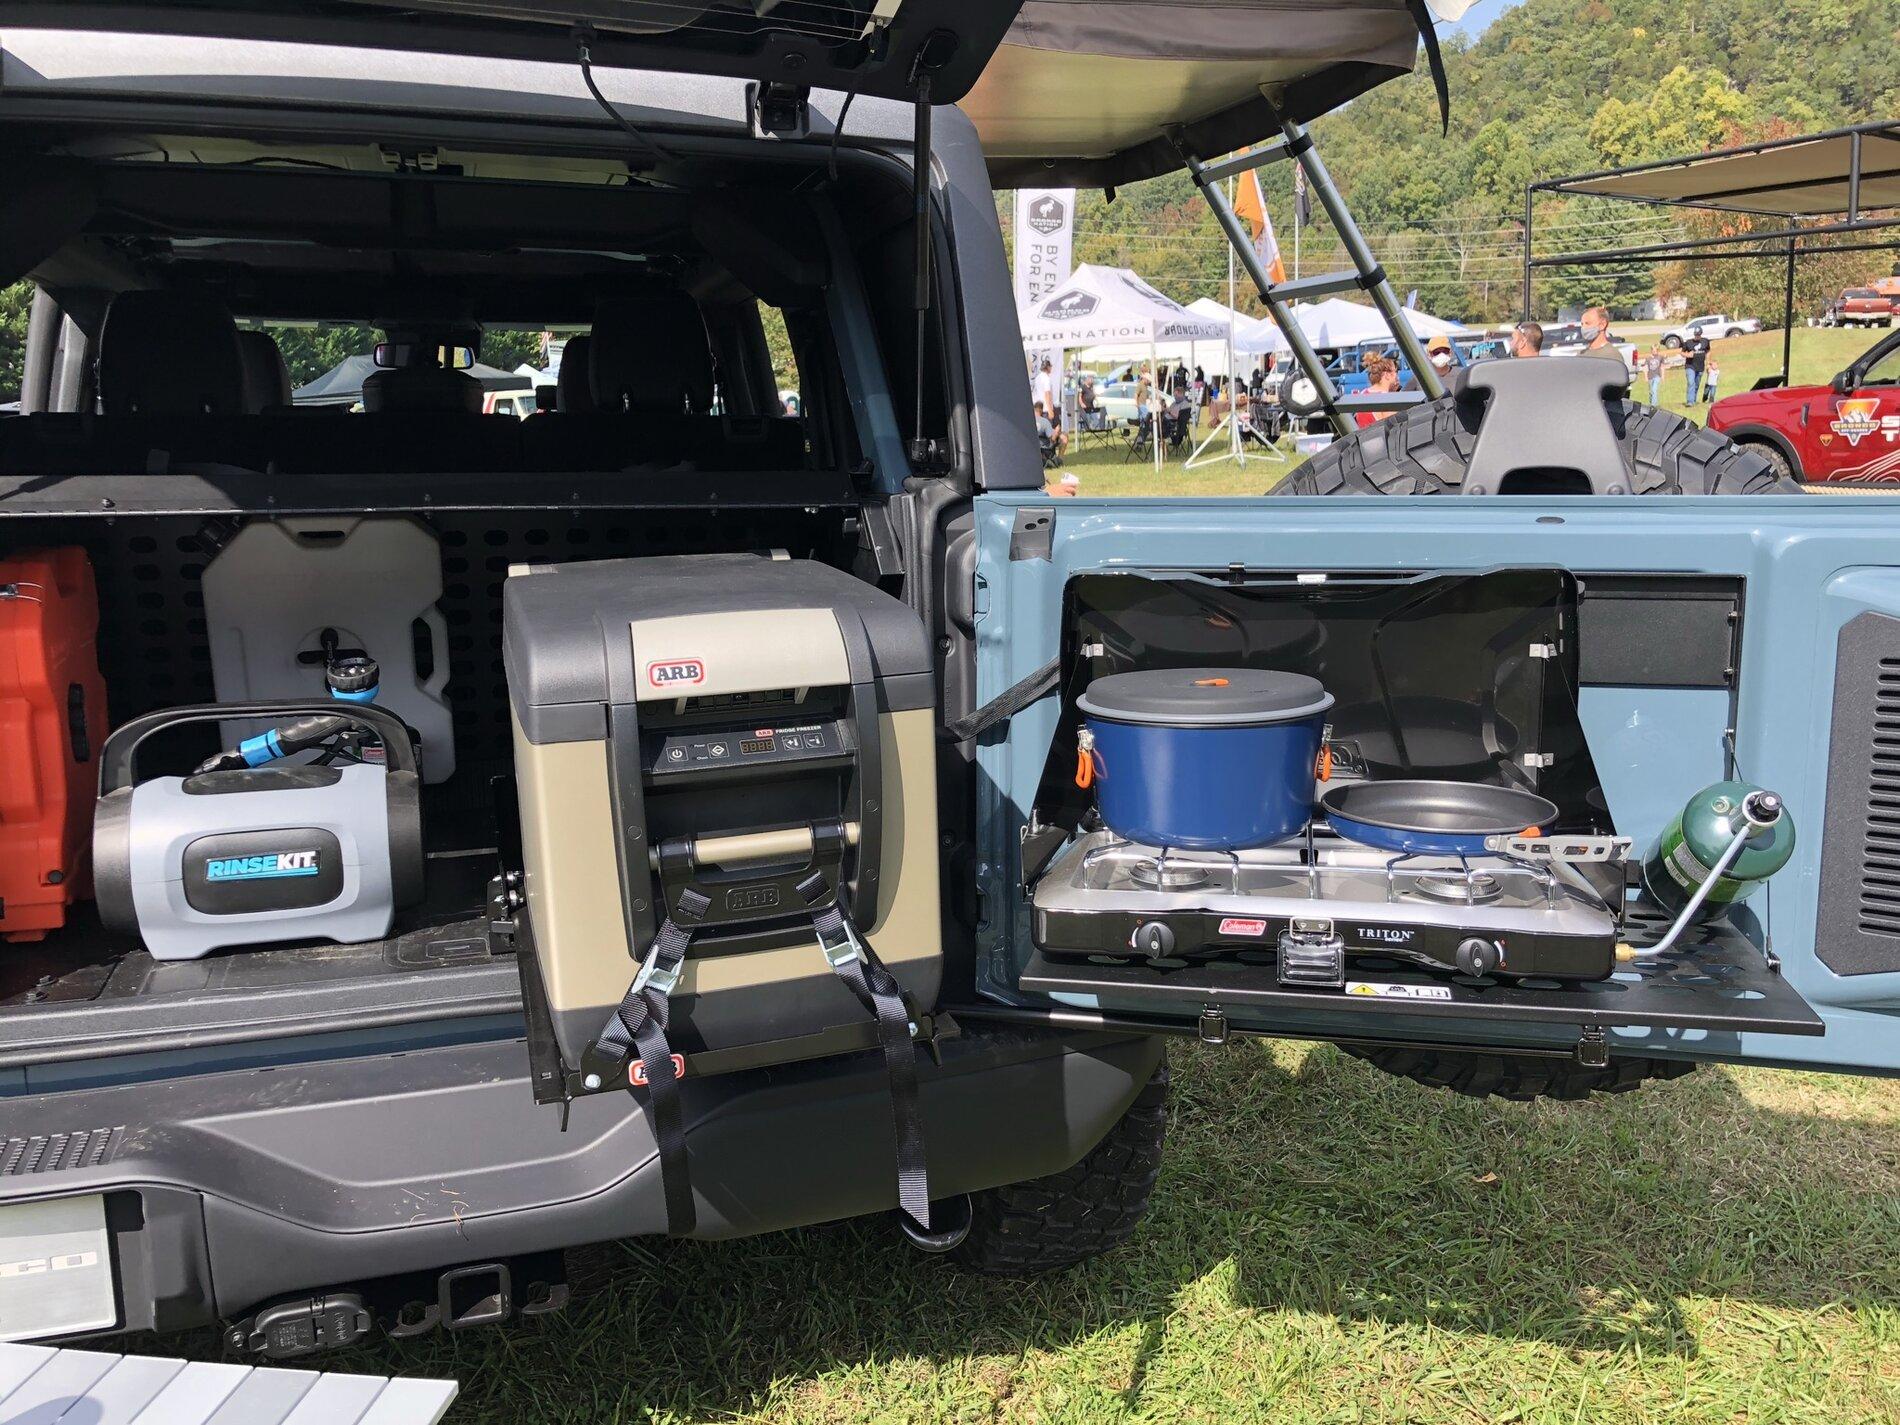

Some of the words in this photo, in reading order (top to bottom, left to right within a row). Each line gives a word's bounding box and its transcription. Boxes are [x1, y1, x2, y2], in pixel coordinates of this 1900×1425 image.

[1029, 244, 1042, 275] FOR
[1046, 245, 1058, 266] BY
[1044, 272, 1056, 294] EN
[1028, 282, 1040, 303] EN
[1022, 332, 1065, 342] NCO
[1070, 326, 1146, 340] NATION
[1881, 415, 1900, 428] S
[1881, 429, 1900, 442] T
[656, 664, 699, 682] ARB
[775, 727, 796, 735] FRIDGE
[796, 724, 822, 733] FREEZER
[1222, 920, 1256, 932] Coleman
